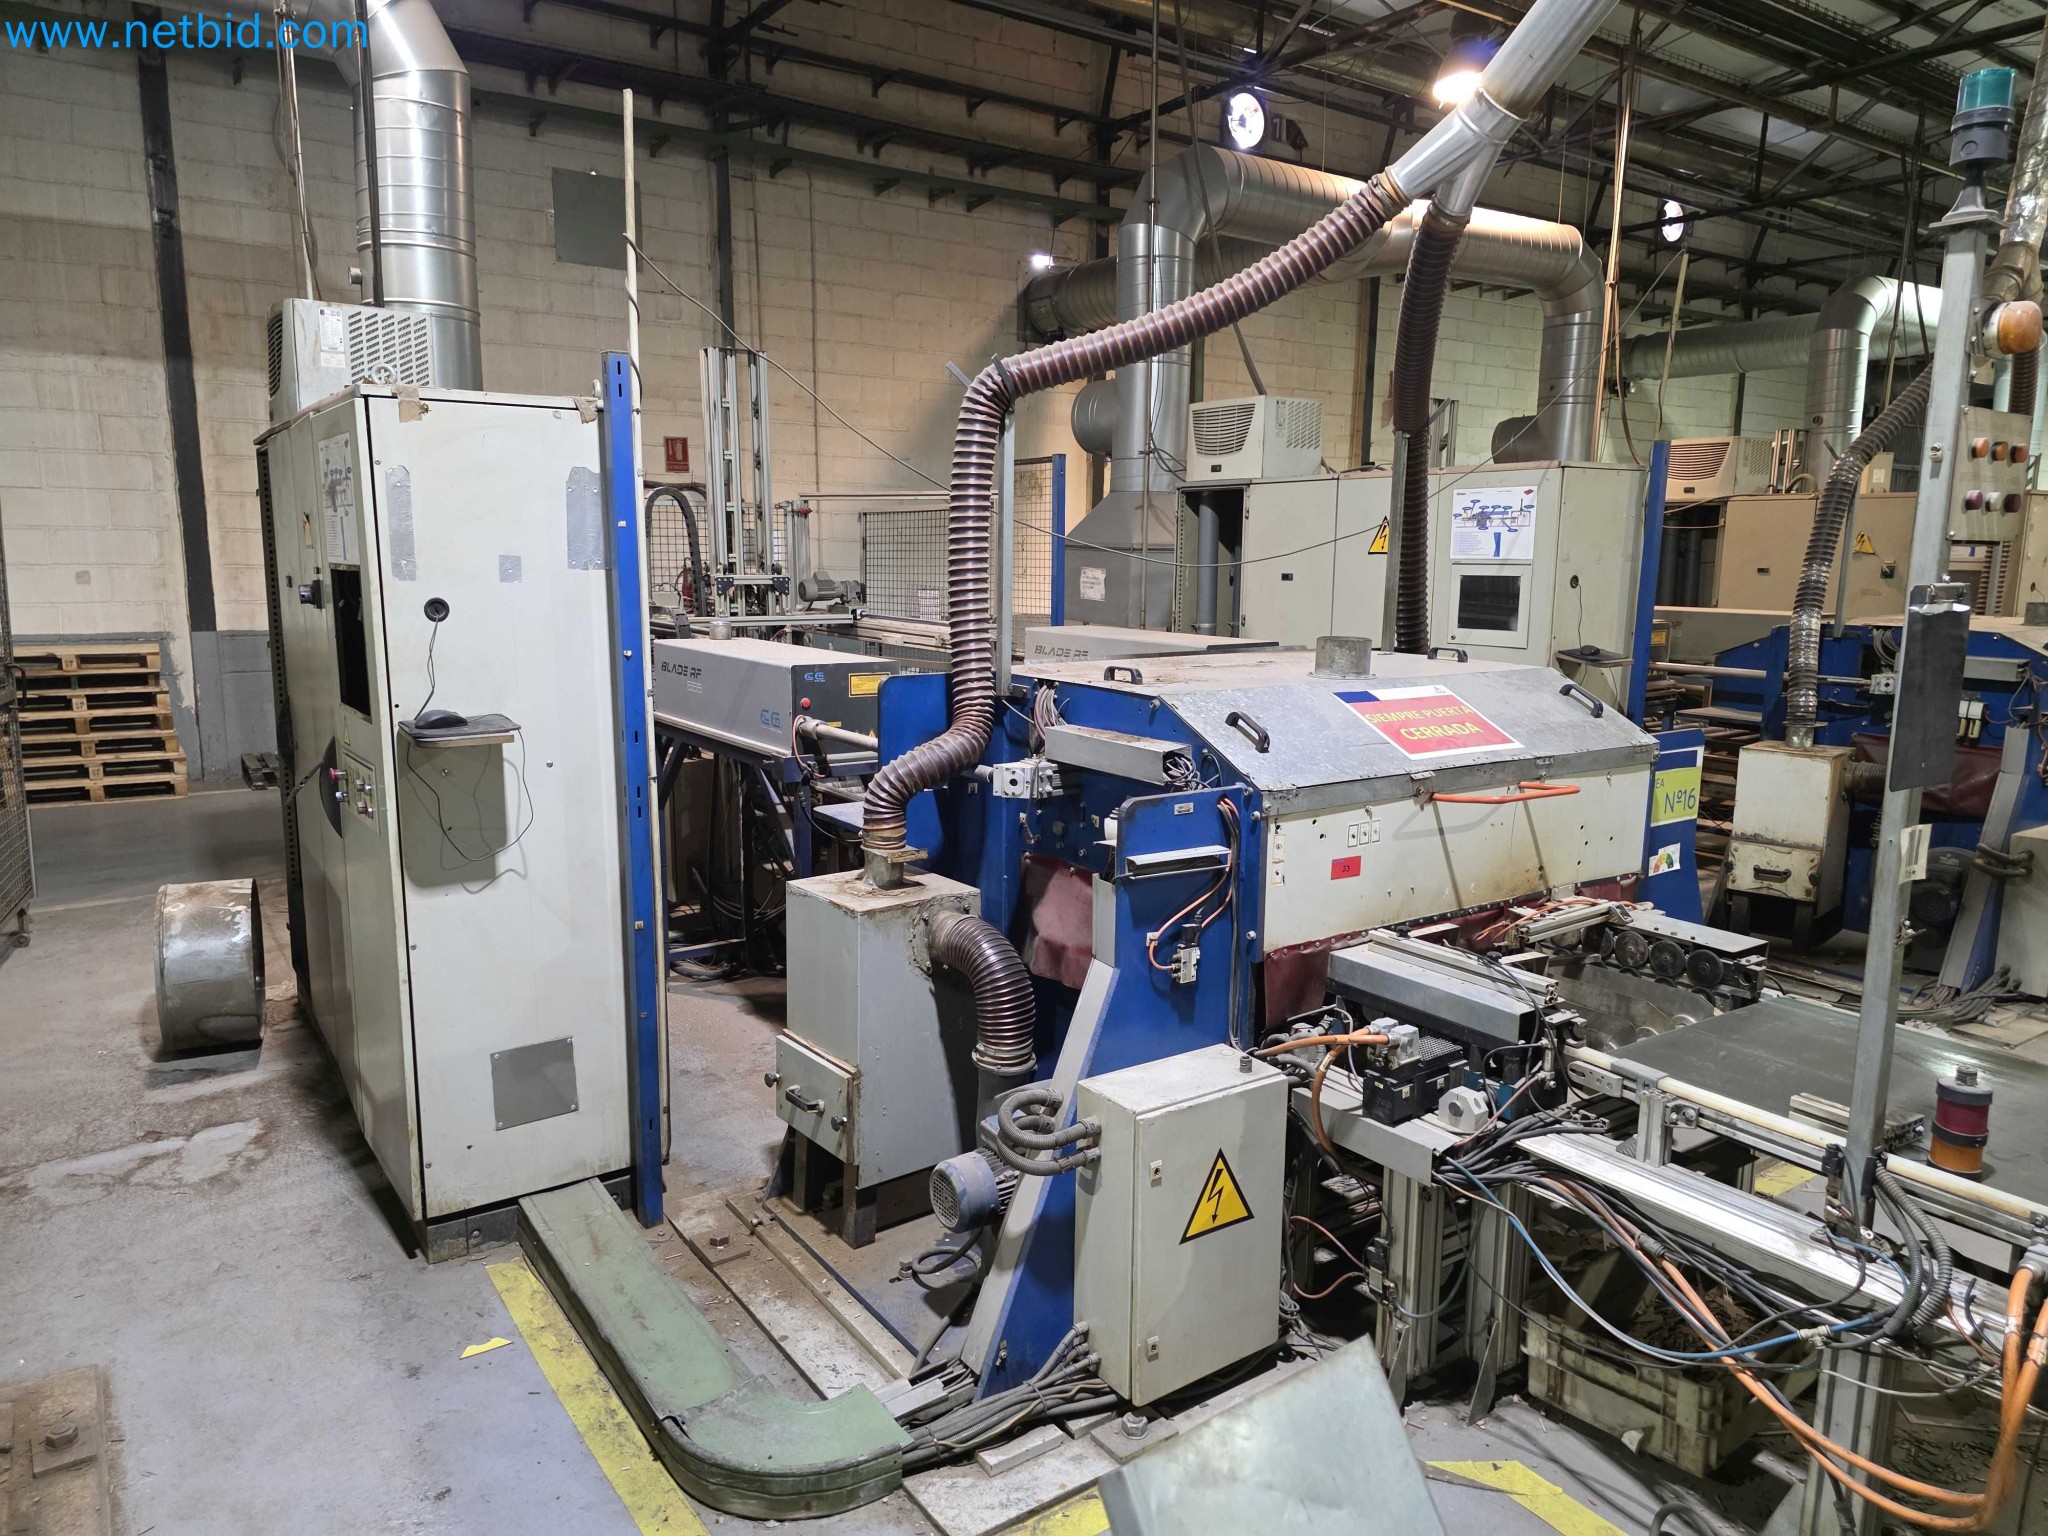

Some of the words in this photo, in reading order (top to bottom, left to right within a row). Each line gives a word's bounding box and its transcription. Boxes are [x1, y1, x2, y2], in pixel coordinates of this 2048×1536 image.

[1035, 645, 1071, 658] BLADE
[661, 661, 688, 677] BLADE
[690, 667, 702, 679] RF
[1364, 710, 1424, 724] SIEMPRE
[1422, 705, 1474, 719] PUERTA
[1400, 722, 1484, 740] CERRADA
